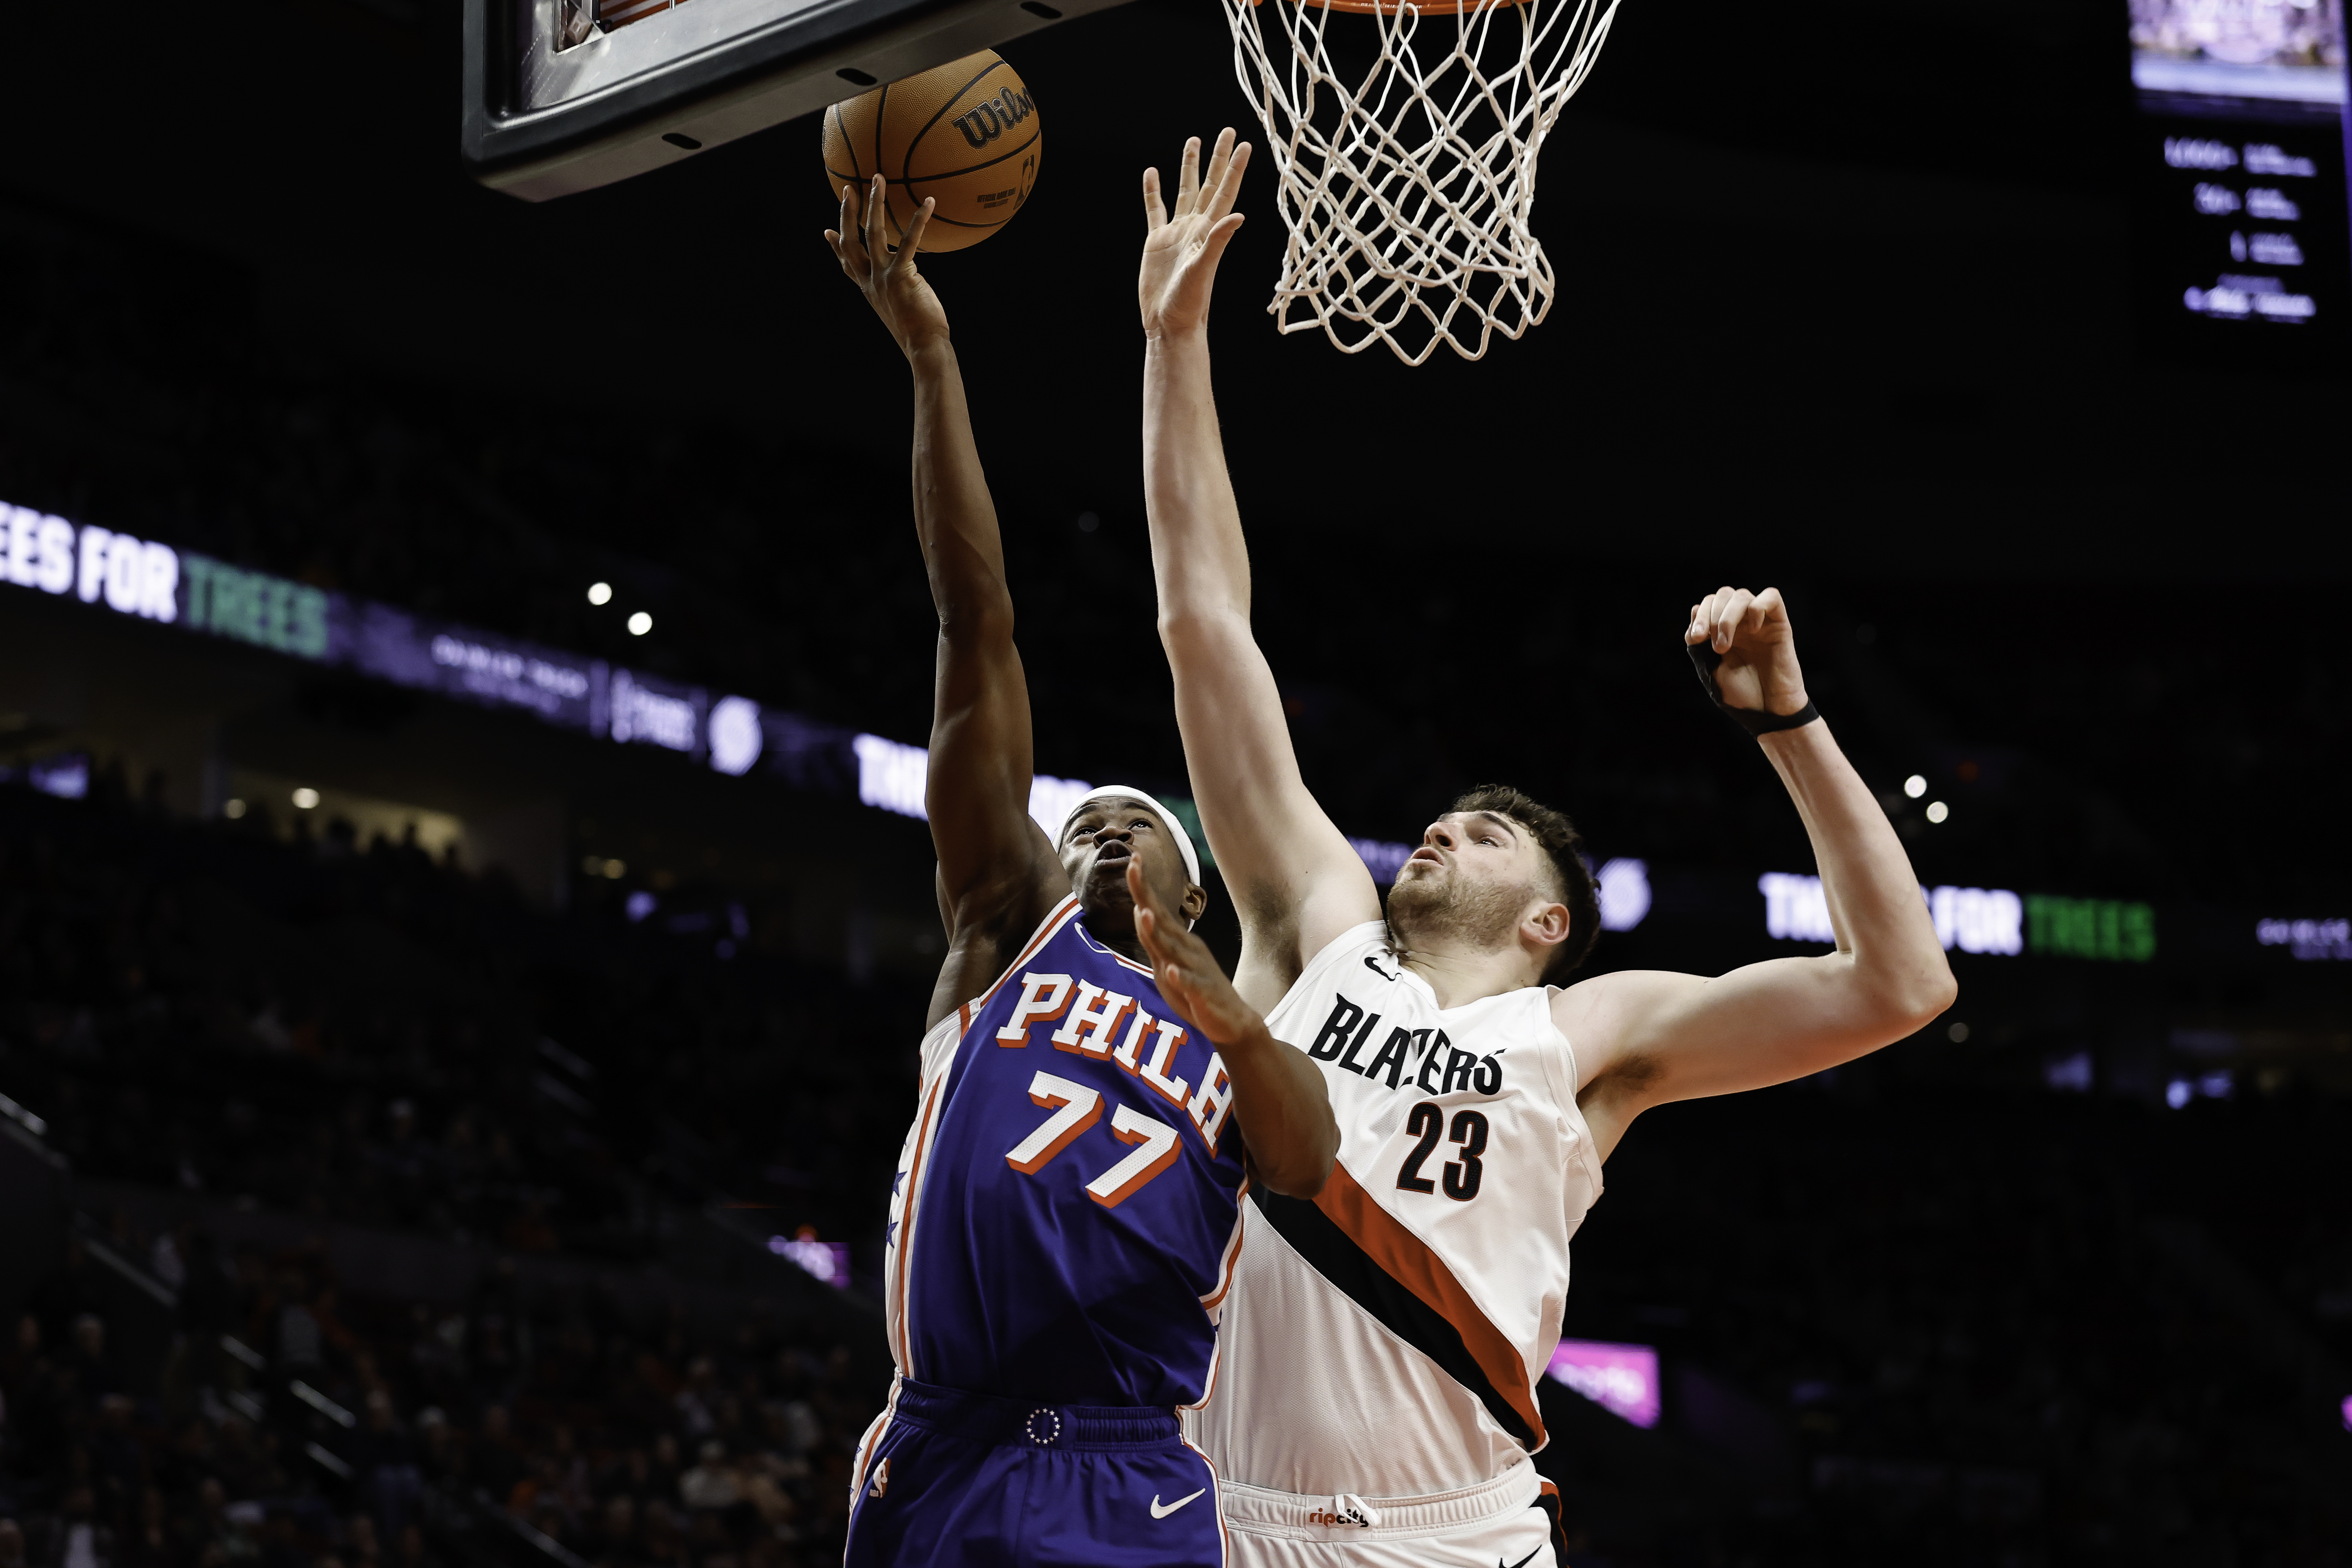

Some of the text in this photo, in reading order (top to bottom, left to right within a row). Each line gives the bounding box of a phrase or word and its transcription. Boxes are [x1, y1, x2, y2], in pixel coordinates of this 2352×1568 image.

[78, 524, 179, 624] FOR
[185, 553, 329, 659] TREES
[2026, 892, 2156, 962] TREES
[1005, 1070, 1183, 1209] 77
[1396, 1102, 1489, 1202] 23
